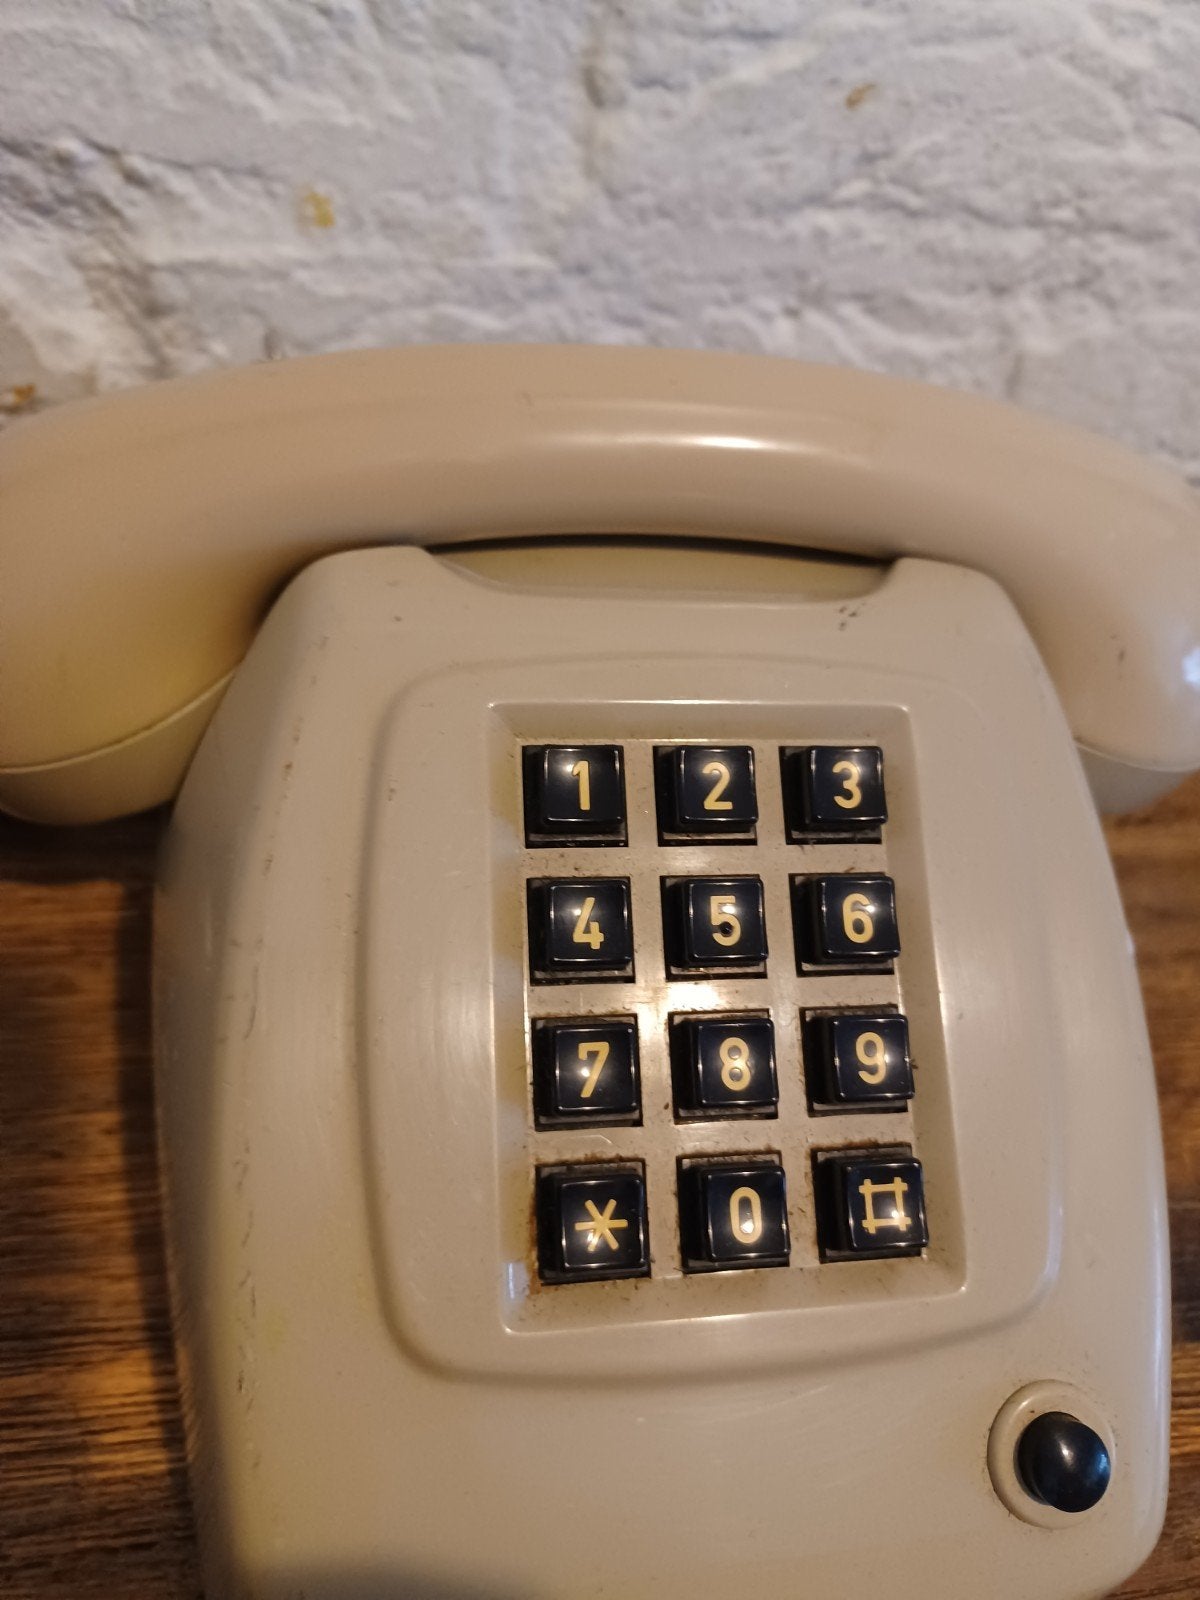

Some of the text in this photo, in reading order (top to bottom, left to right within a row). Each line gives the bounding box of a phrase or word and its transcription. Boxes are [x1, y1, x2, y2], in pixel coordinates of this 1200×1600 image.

[571, 759, 591, 811] 1
[701, 760, 733, 811] 2
[832, 759, 862, 809] 3
[571, 896, 605, 949] 4
[709, 894, 742, 947] 5
[841, 892, 874, 944] 6
[577, 1041, 610, 1099] 7
[718, 1036, 752, 1092] 8
[854, 1031, 888, 1085] 9
[729, 1186, 764, 1245] 0
